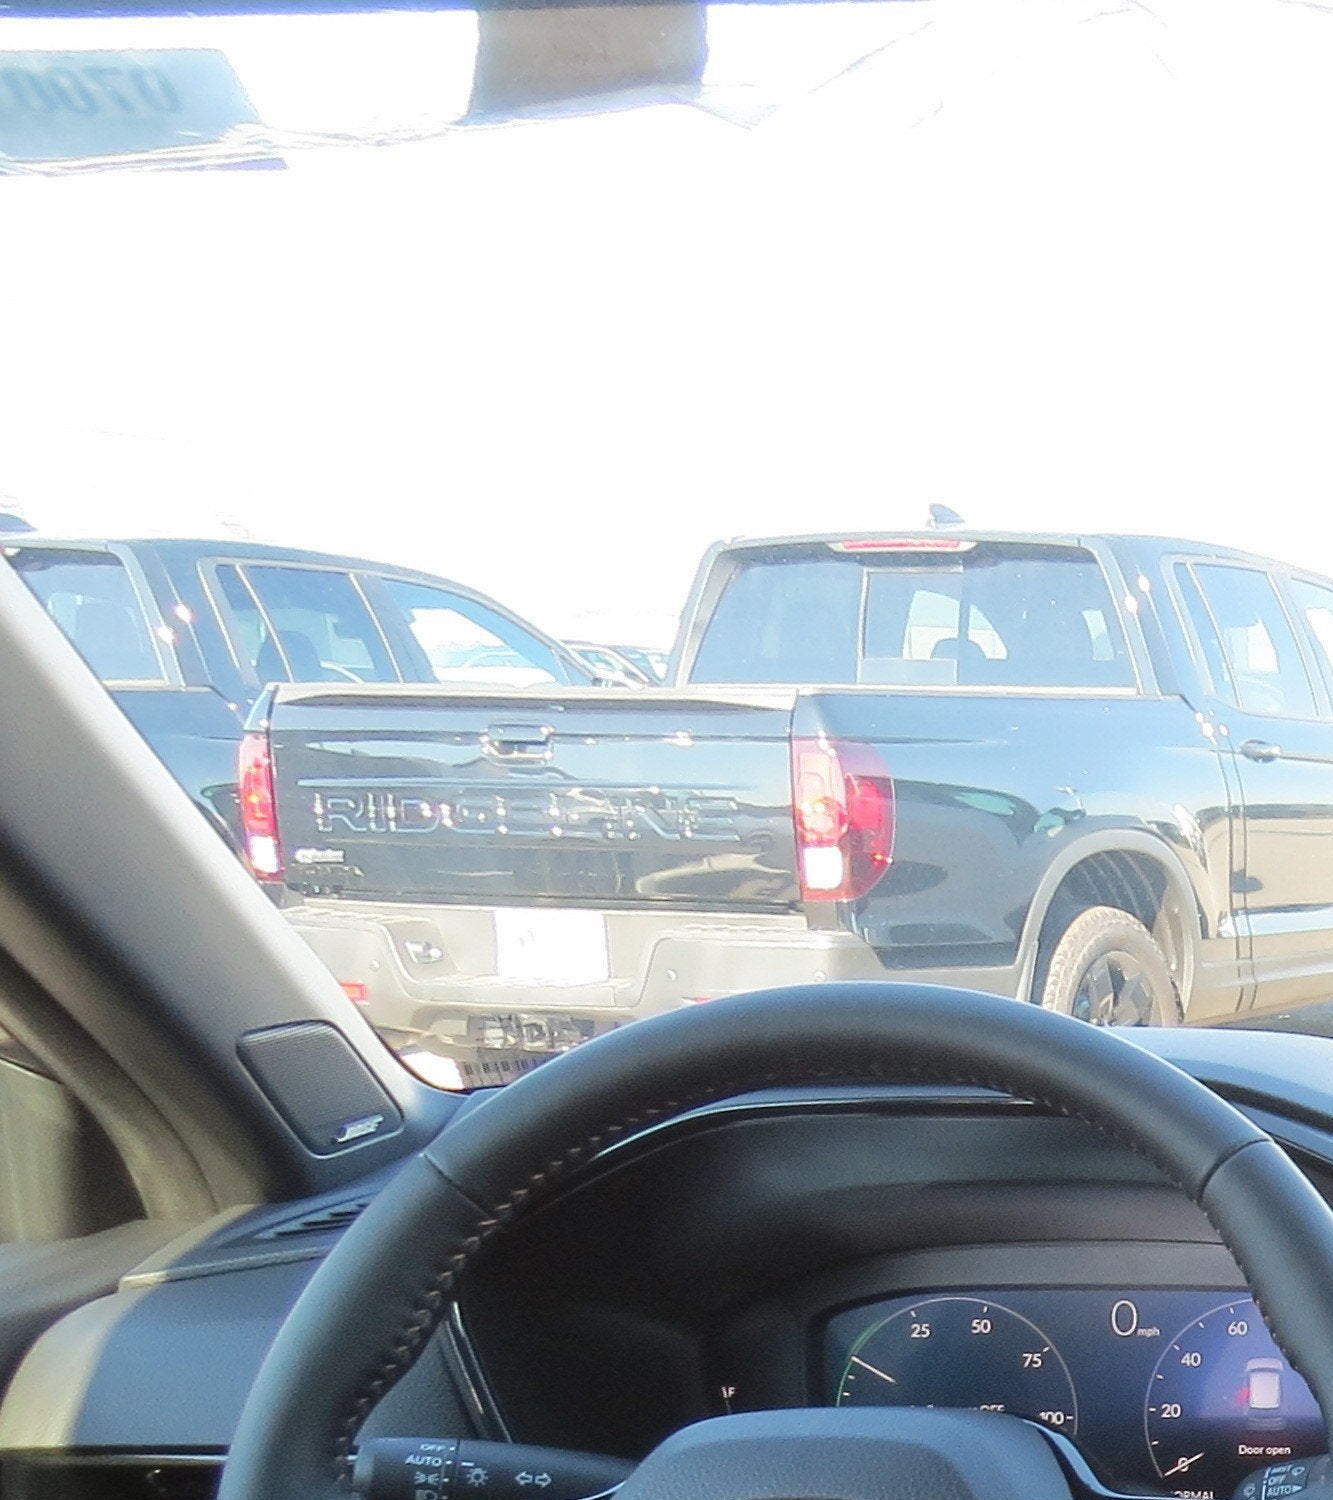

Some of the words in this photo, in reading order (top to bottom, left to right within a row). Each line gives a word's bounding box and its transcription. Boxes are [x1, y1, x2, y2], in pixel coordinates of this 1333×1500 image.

[971, 1319, 992, 1335] 50
[1111, 1300, 1138, 1337] 0
[1138, 1326, 1160, 1339] mph
[910, 1323, 931, 1339] 25
[1228, 1321, 1248, 1336] 60
[1022, 1353, 1042, 1368] 75
[1181, 1352, 1202, 1367] 40
[1161, 1403, 1181, 1418] 20
[1038, 1411, 1065, 1426] 100
[1238, 1444, 1264, 1455] Door
[1267, 1446, 1292, 1457] open
[404, 1453, 442, 1467] AUTO
[1266, 1484, 1292, 1497] AUTO
